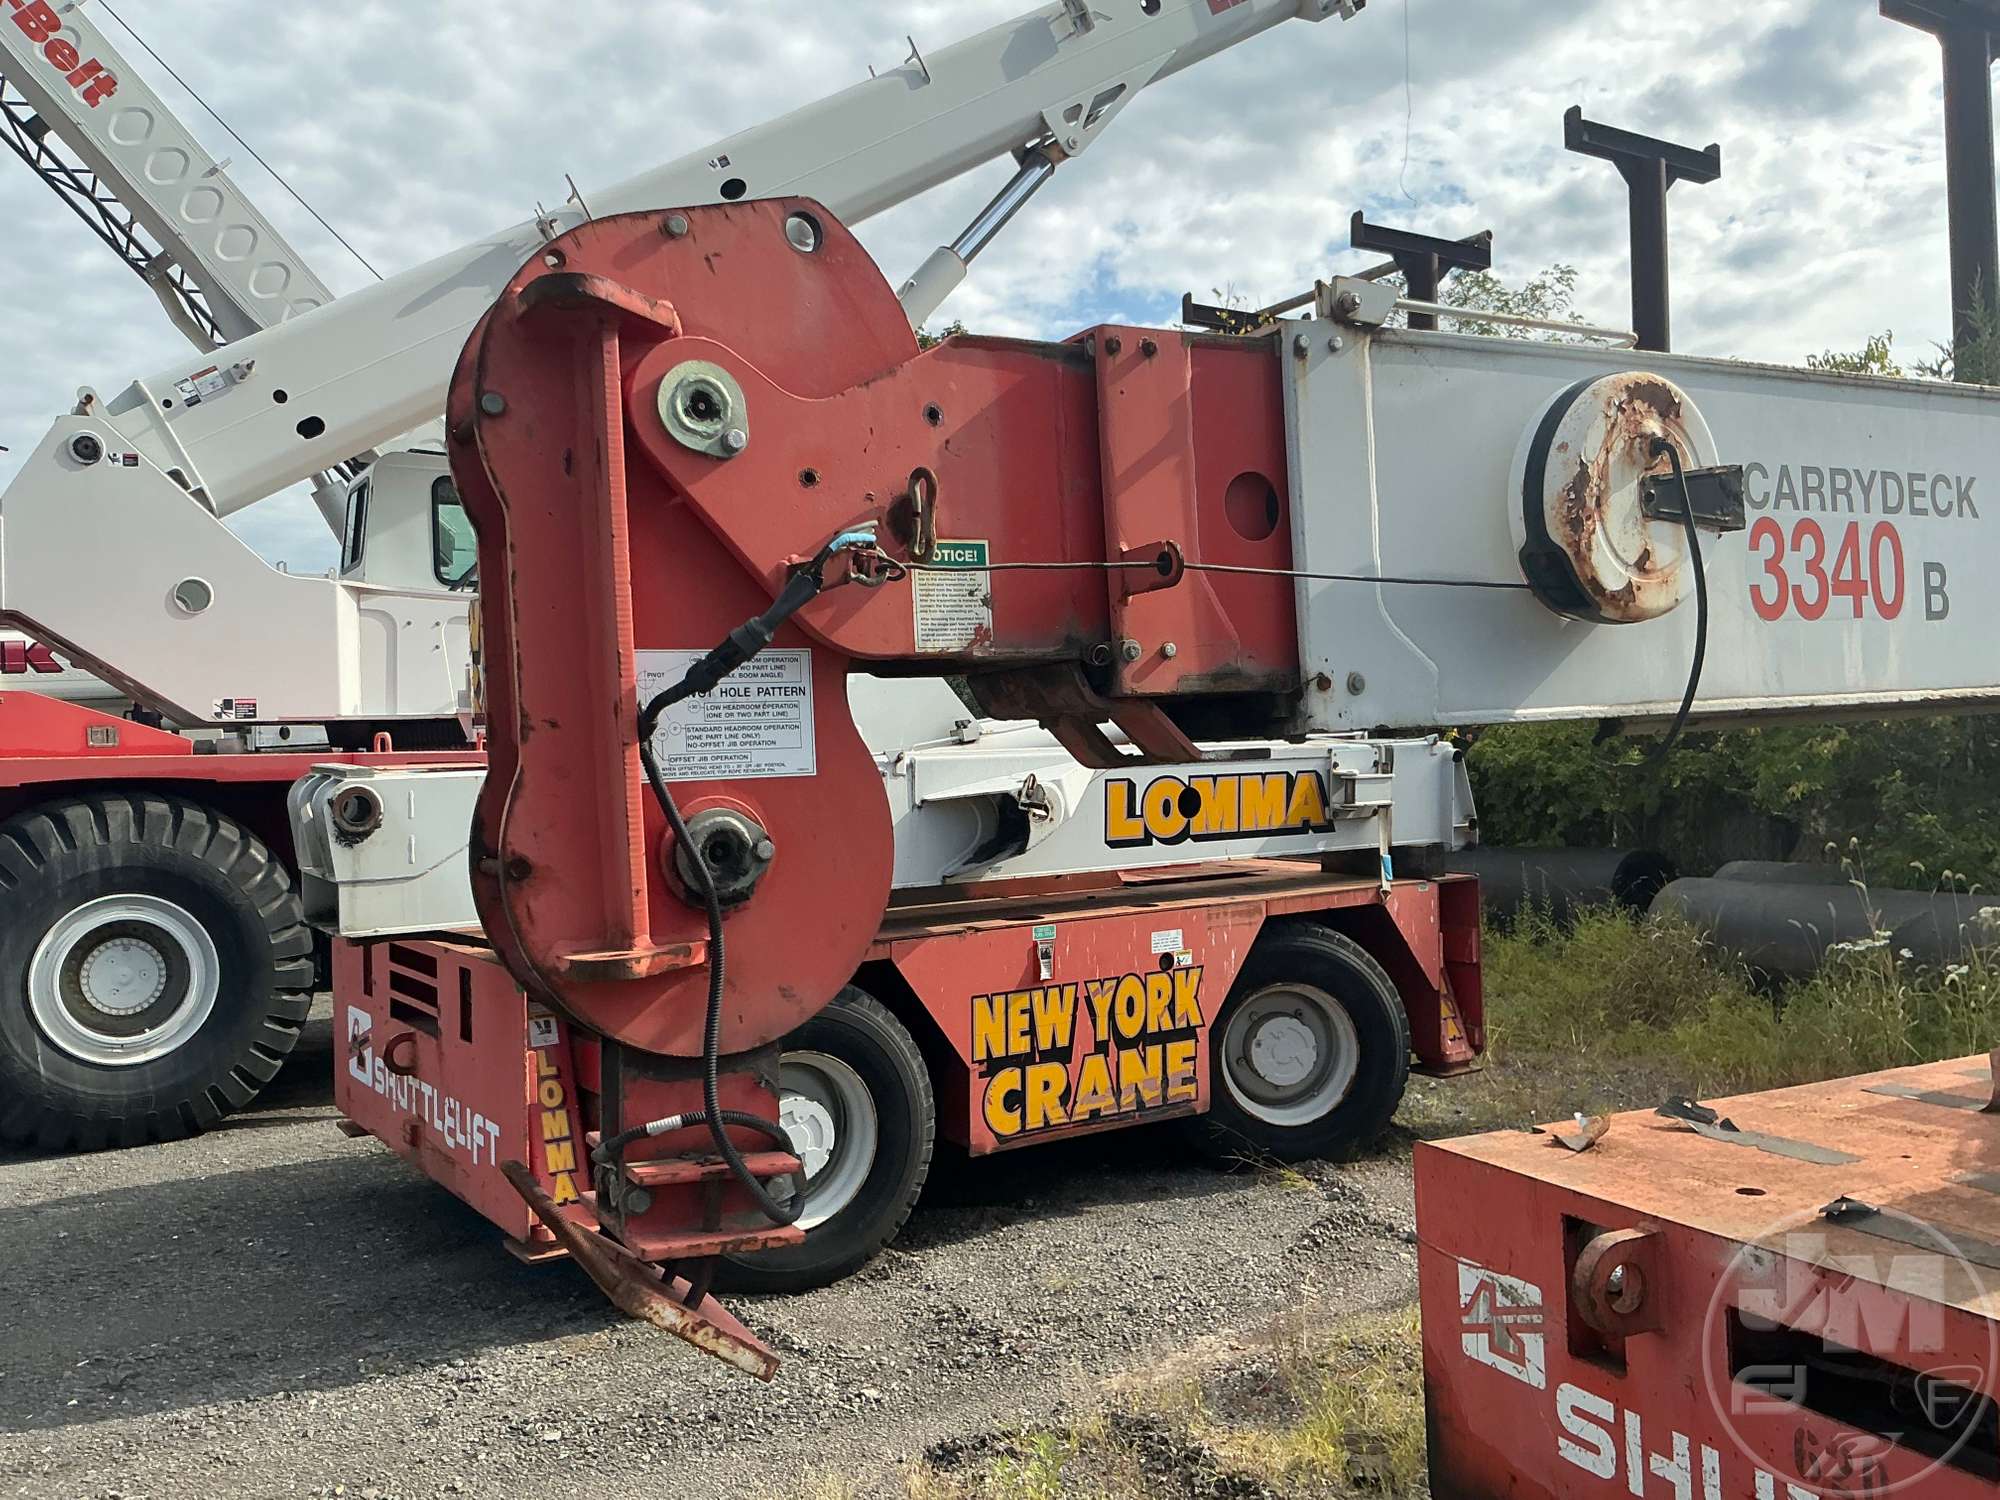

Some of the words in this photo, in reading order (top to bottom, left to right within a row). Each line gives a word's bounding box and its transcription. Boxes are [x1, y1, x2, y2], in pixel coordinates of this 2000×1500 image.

[1744, 462, 1980, 519] CARRYDECK
[933, 549, 977, 562] OTICE!
[1748, 515, 1905, 622] 3340
[1922, 560, 1950, 622] B
[720, 687, 751, 698] HOLE
[757, 686, 806, 697] PATTERN
[1105, 770, 1333, 847] LOMMA
[971, 981, 1079, 1064] NEW
[1084, 965, 1205, 1045] YORK
[537, 1049, 583, 1204] LOMMA
[982, 1040, 1200, 1141] CRANE
